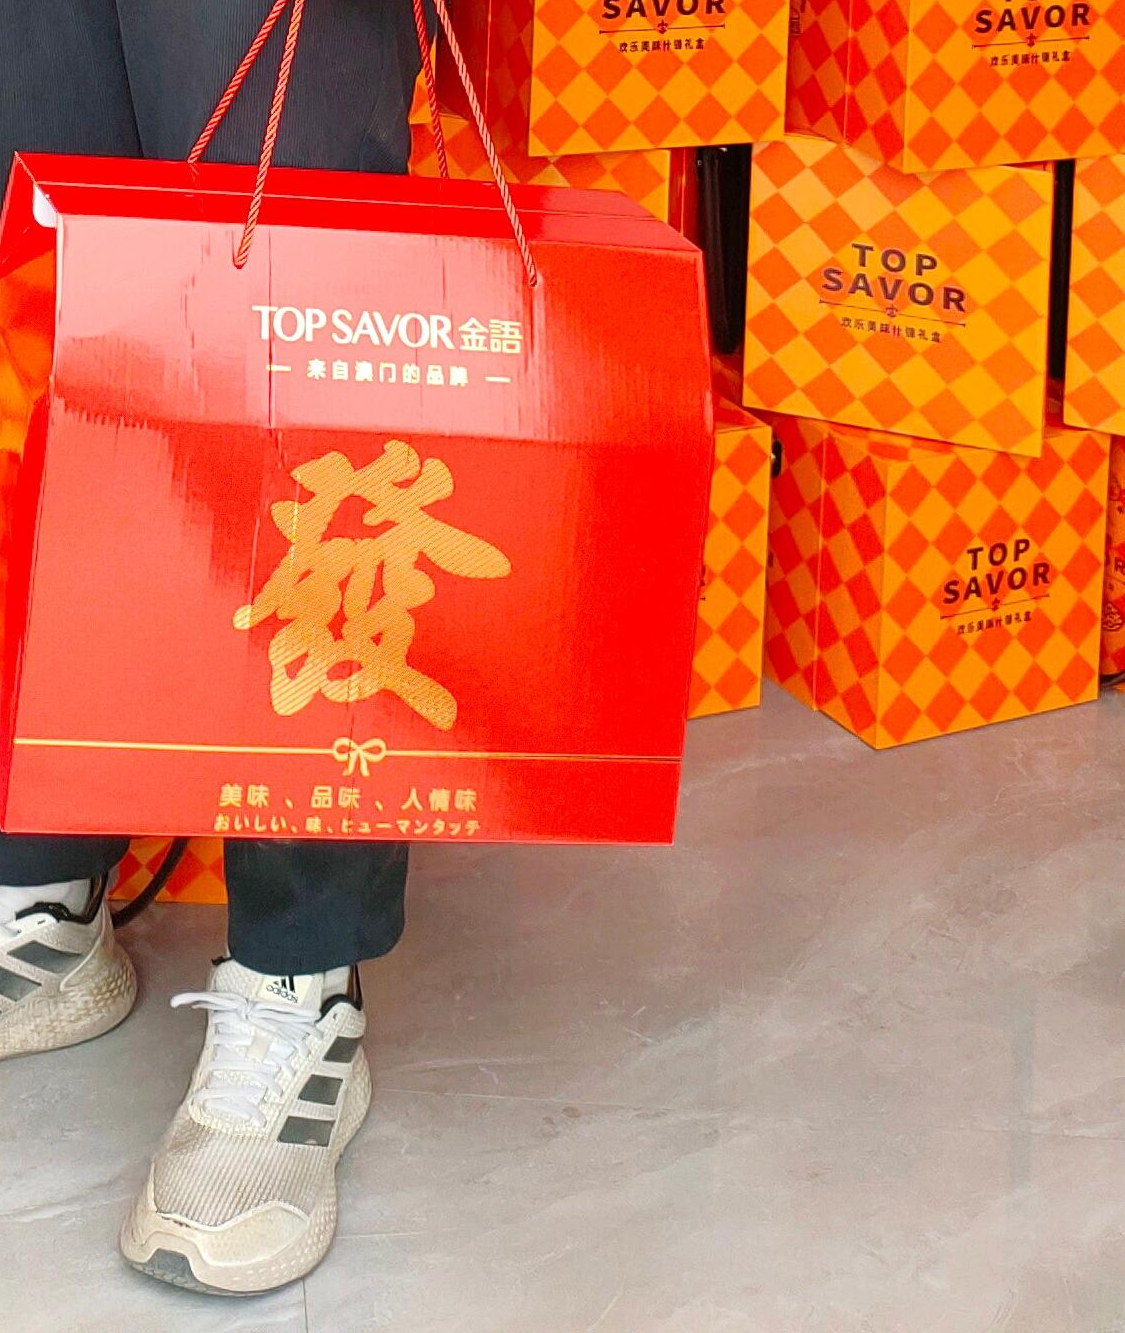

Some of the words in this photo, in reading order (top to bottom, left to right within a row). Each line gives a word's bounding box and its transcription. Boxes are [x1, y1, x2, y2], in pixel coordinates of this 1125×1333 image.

[974, 2, 1091, 34] SAVOR
[851, 243, 938, 276] TOP
[821, 267, 966, 313] SAVOR
[252, 305, 326, 342] TOP
[331, 309, 455, 350] SAVOR
[458, 317, 524, 354] 金語
[967, 538, 1030, 571] TOP
[233, 439, 512, 733] 發
[942, 562, 1051, 605] SAVOR
